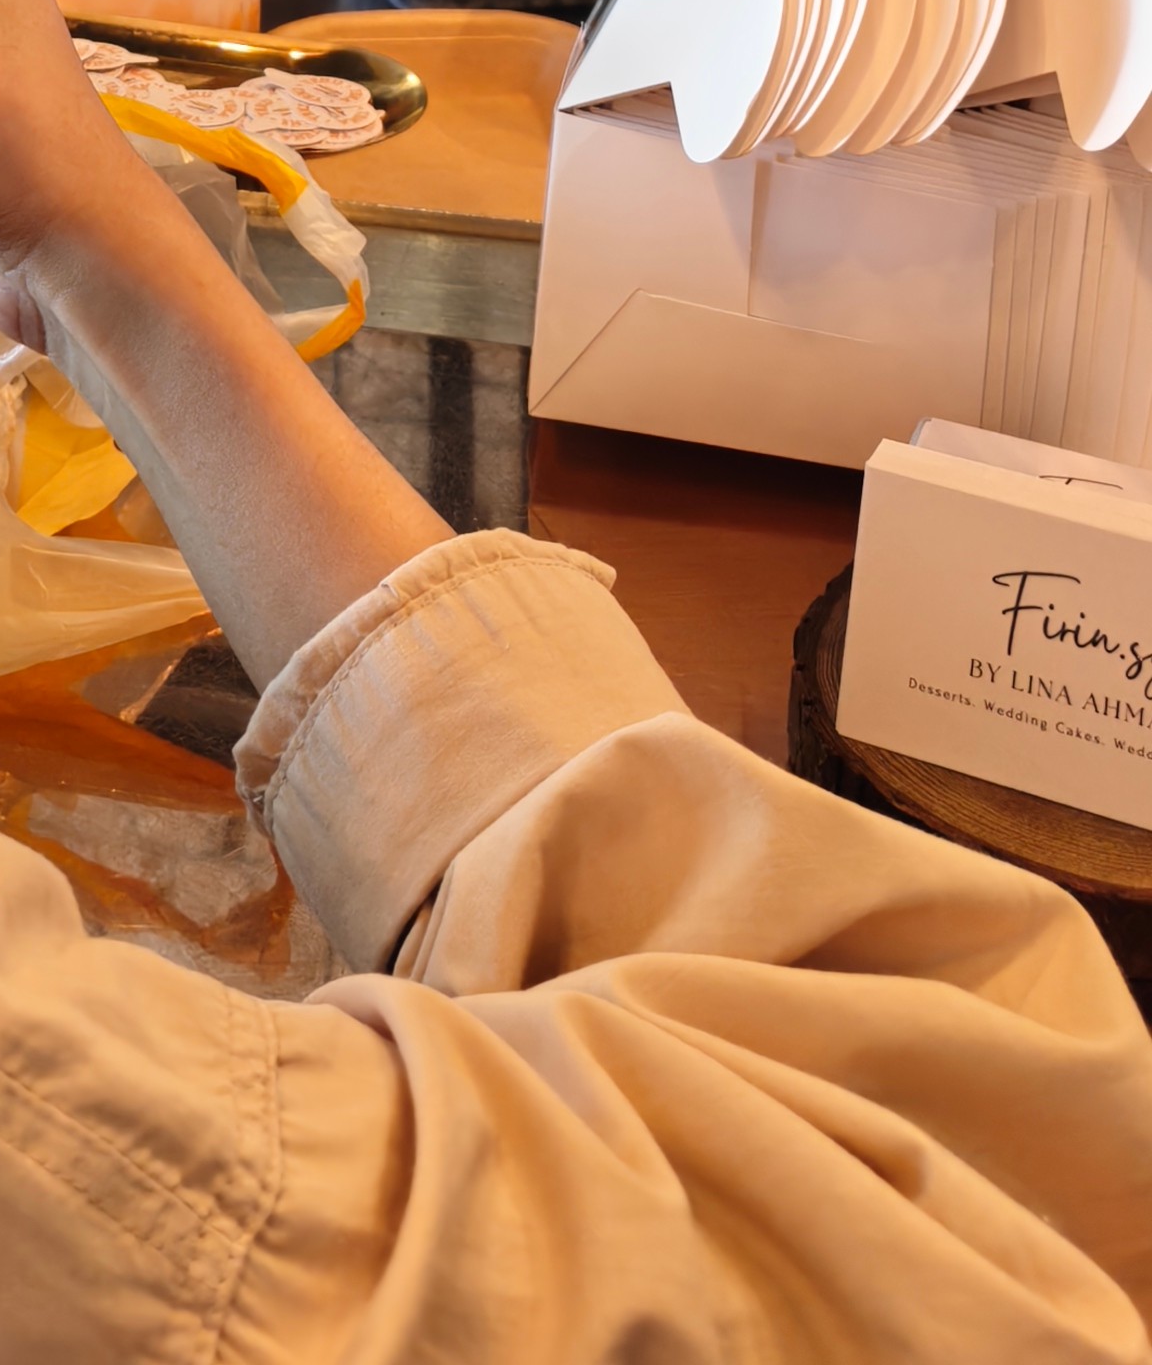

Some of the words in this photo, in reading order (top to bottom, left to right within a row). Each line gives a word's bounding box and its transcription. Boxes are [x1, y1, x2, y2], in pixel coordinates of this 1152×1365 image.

[969, 658, 1002, 684] BY
[1010, 670, 1073, 707] LINA
[984, 699, 1049, 732] Wedding
